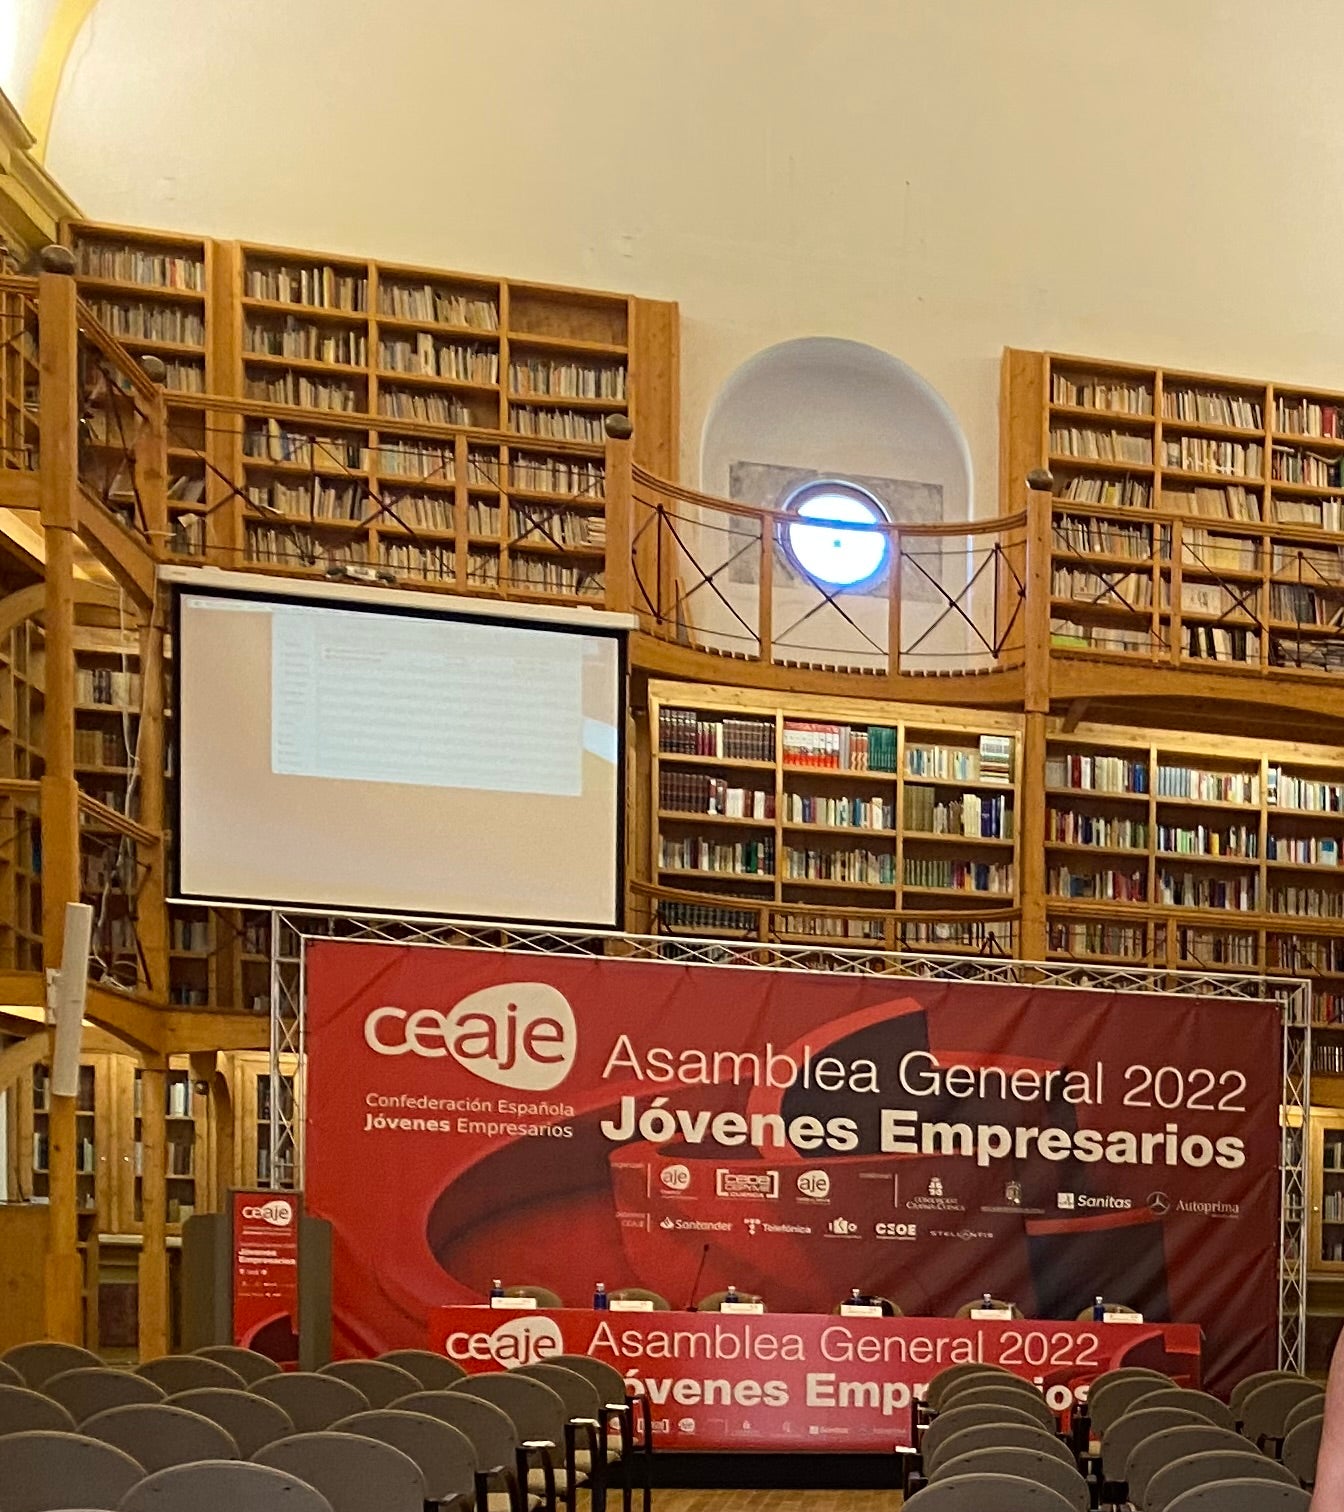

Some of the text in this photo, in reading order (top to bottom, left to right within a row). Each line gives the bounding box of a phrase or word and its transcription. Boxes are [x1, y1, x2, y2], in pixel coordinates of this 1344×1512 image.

[363, 1002, 566, 1071] ceaje
[602, 1034, 1246, 1112] Asamblea General 2022
[366, 1093, 575, 1117] Confederación Española
[364, 1113, 573, 1138] Jóvenes Empresarios
[600, 1096, 1246, 1169] Jóvenes Empresarios
[662, 1167, 689, 1187] aje
[799, 1173, 829, 1194] aje
[1077, 1194, 1132, 1209] Sanitas
[1175, 1199, 1240, 1215] Autoprima
[675, 1219, 733, 1232] Santander
[762, 1222, 812, 1234] Telefónica
[445, 1328, 557, 1366] ceaje
[587, 1321, 1099, 1367] Asamblea General 2022
[622, 1368, 790, 1408] óvenes
